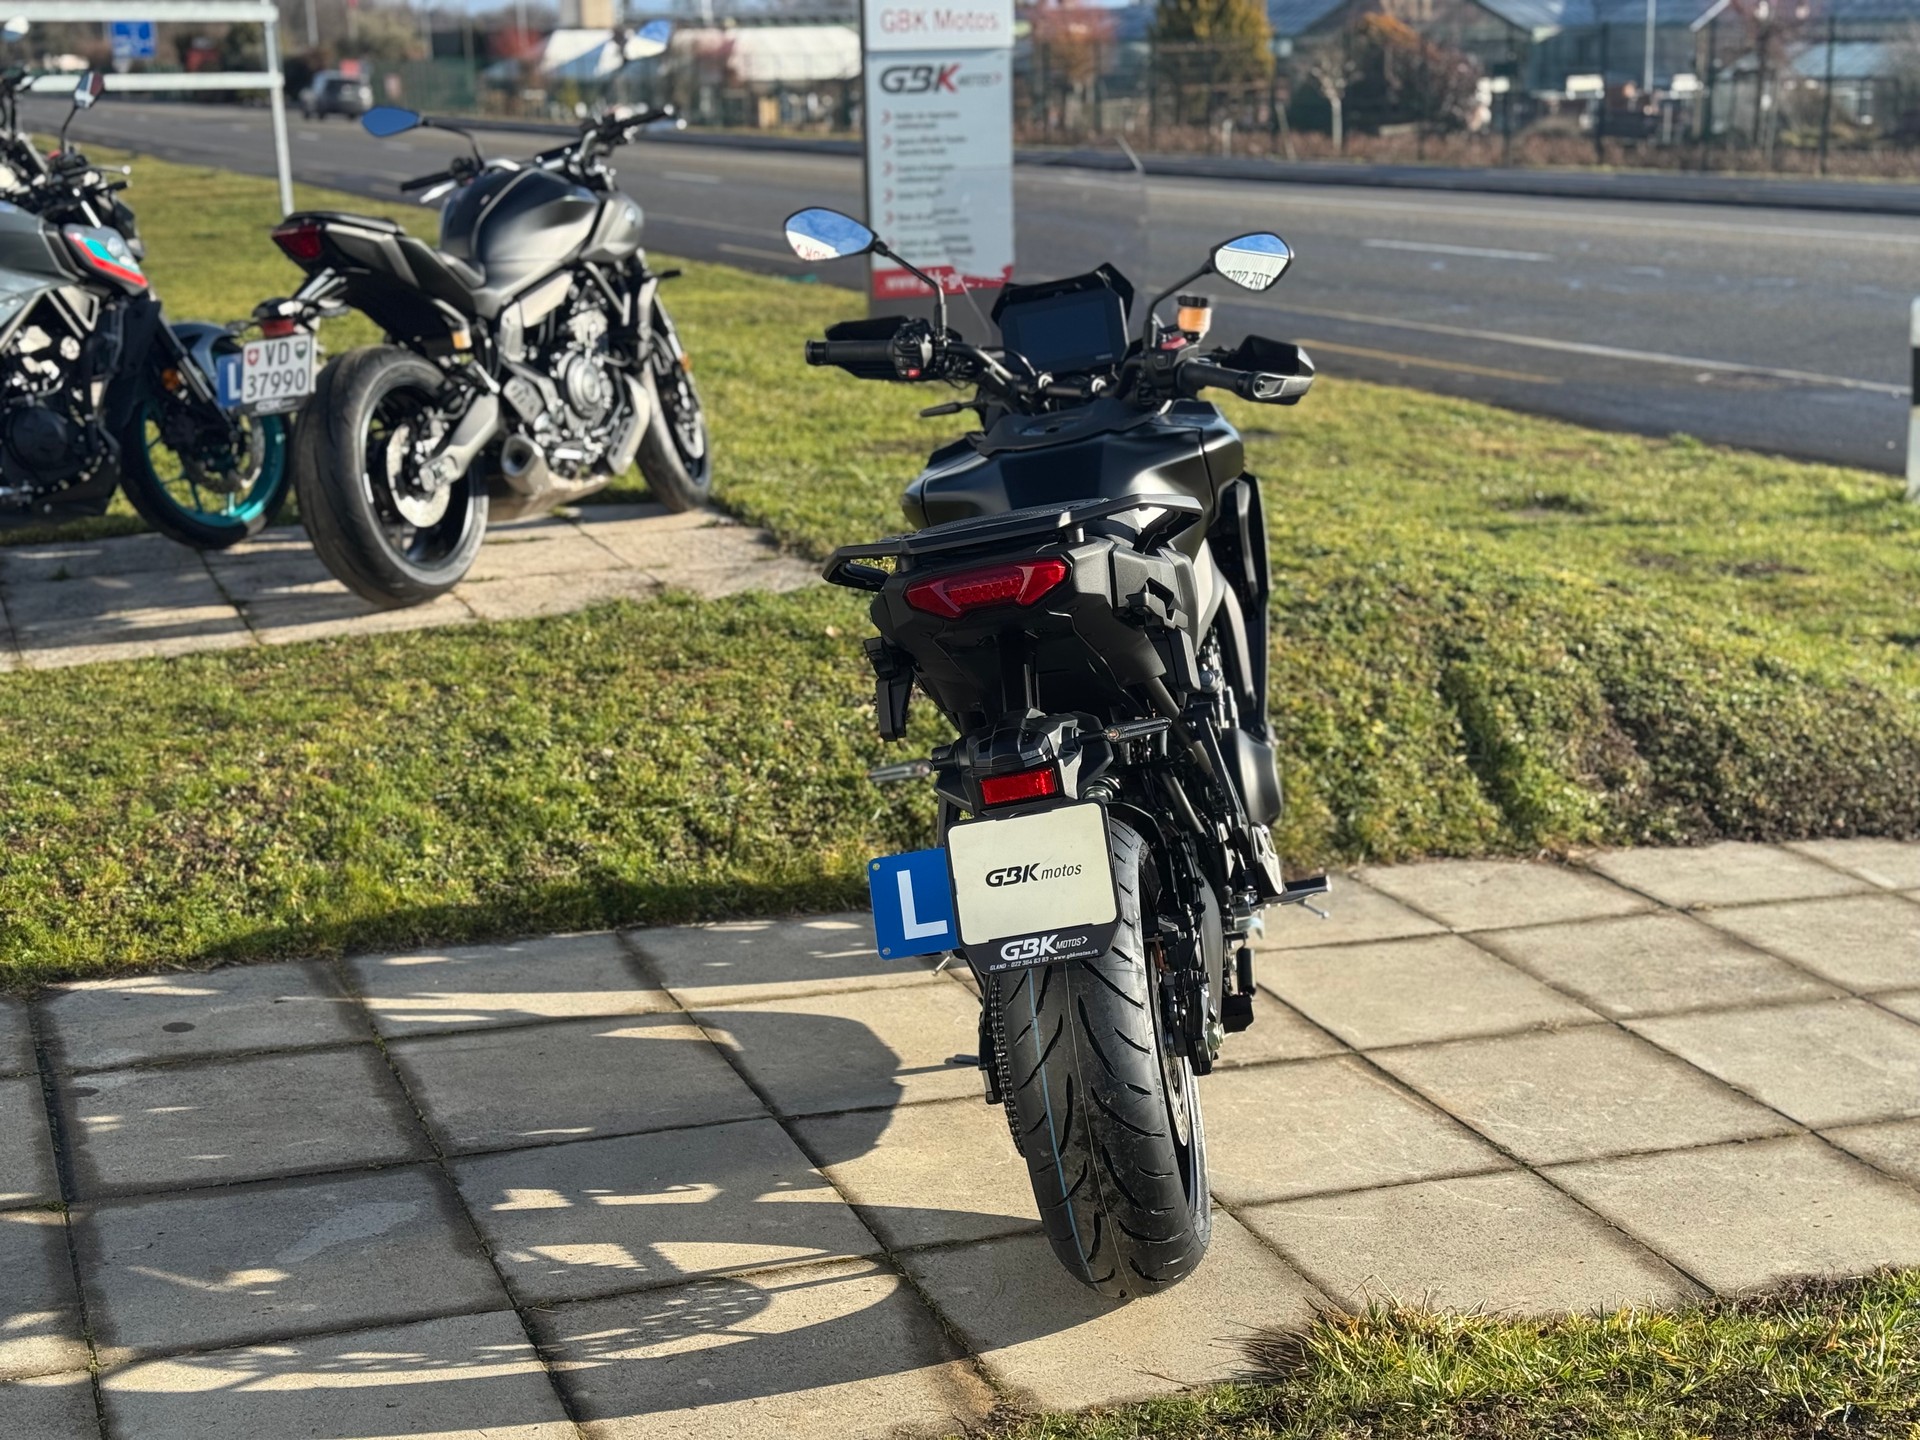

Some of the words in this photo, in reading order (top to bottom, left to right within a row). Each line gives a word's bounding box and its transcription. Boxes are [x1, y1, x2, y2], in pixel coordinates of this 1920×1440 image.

[880, 9, 927, 33] GBK
[934, 10, 999, 31] Motos
[880, 63, 961, 94] GBK
[265, 341, 290, 367] VD
[227, 362, 241, 400] L
[246, 367, 307, 399] 37990
[985, 862, 1041, 888] GBK
[1041, 863, 1082, 881] motos
[896, 869, 948, 941] L
[1000, 934, 1058, 961] GBK
[1056, 937, 1082, 950] MOTOS
